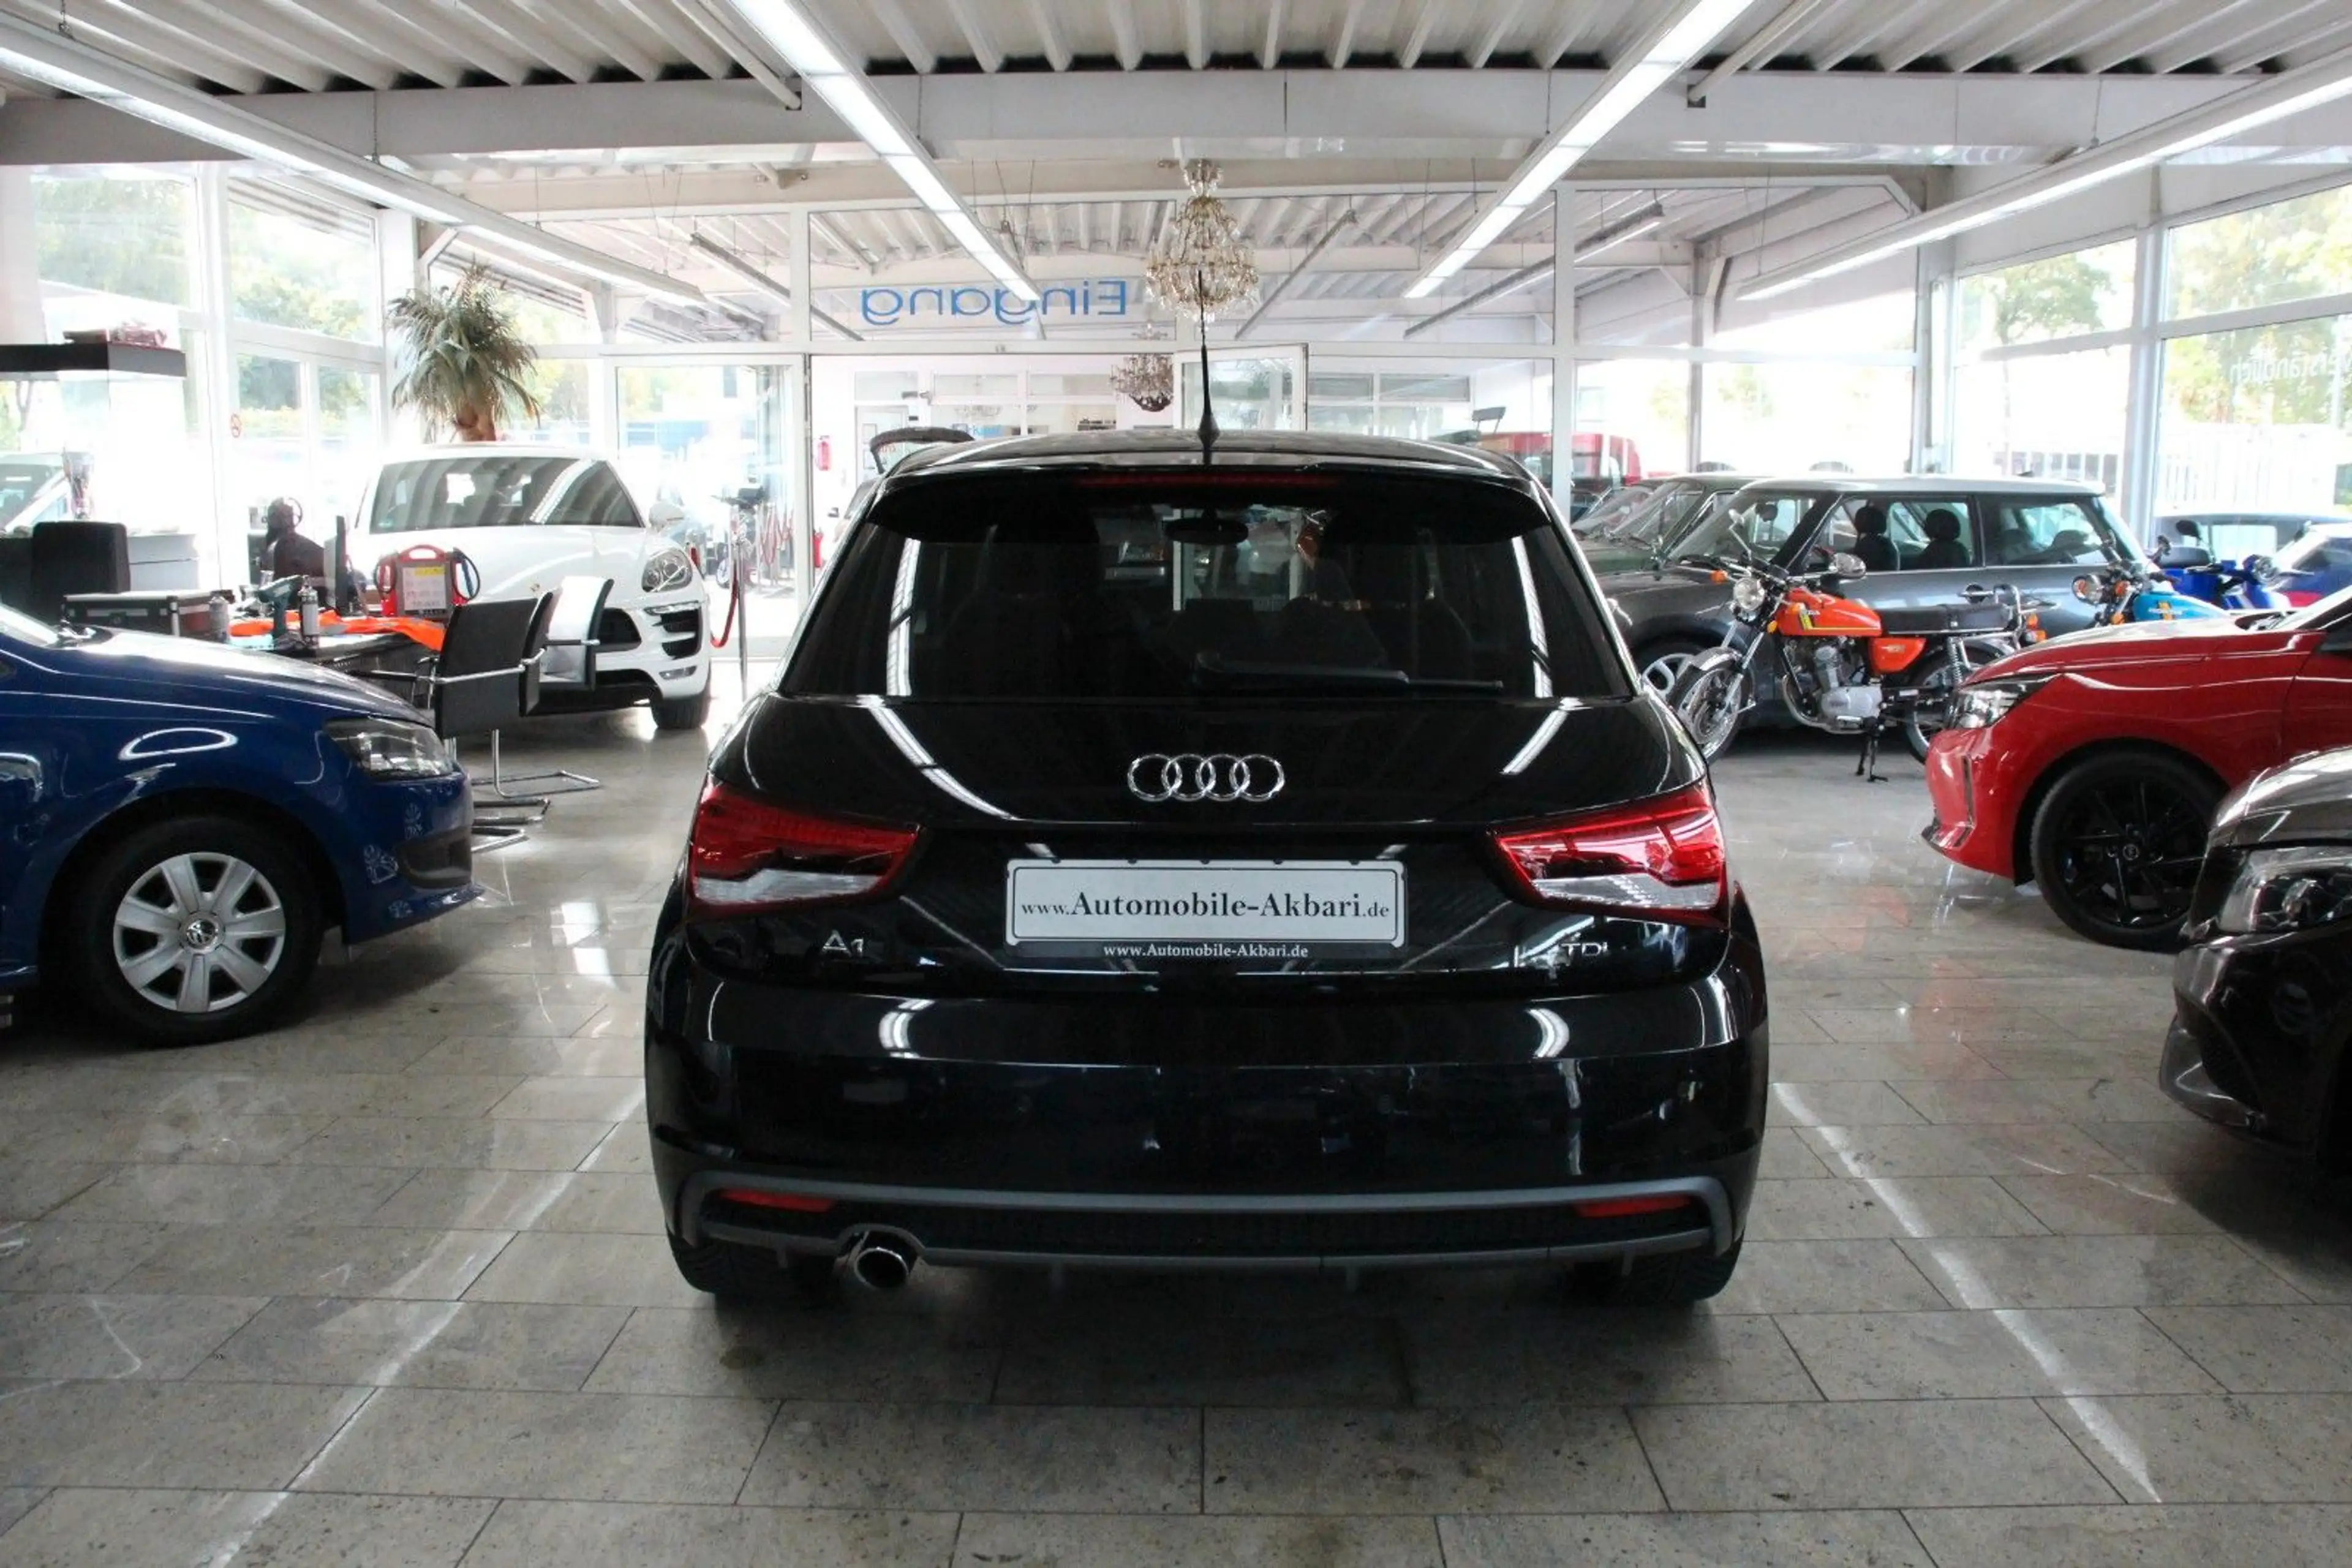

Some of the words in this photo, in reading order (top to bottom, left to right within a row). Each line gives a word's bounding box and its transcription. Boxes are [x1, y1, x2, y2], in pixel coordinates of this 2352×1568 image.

[1021, 891, 1390, 918] www.Automobile-Akbari.de
[822, 930, 864, 958] A1
[1103, 943, 1309, 958] www.Automobile-Akbari.de
